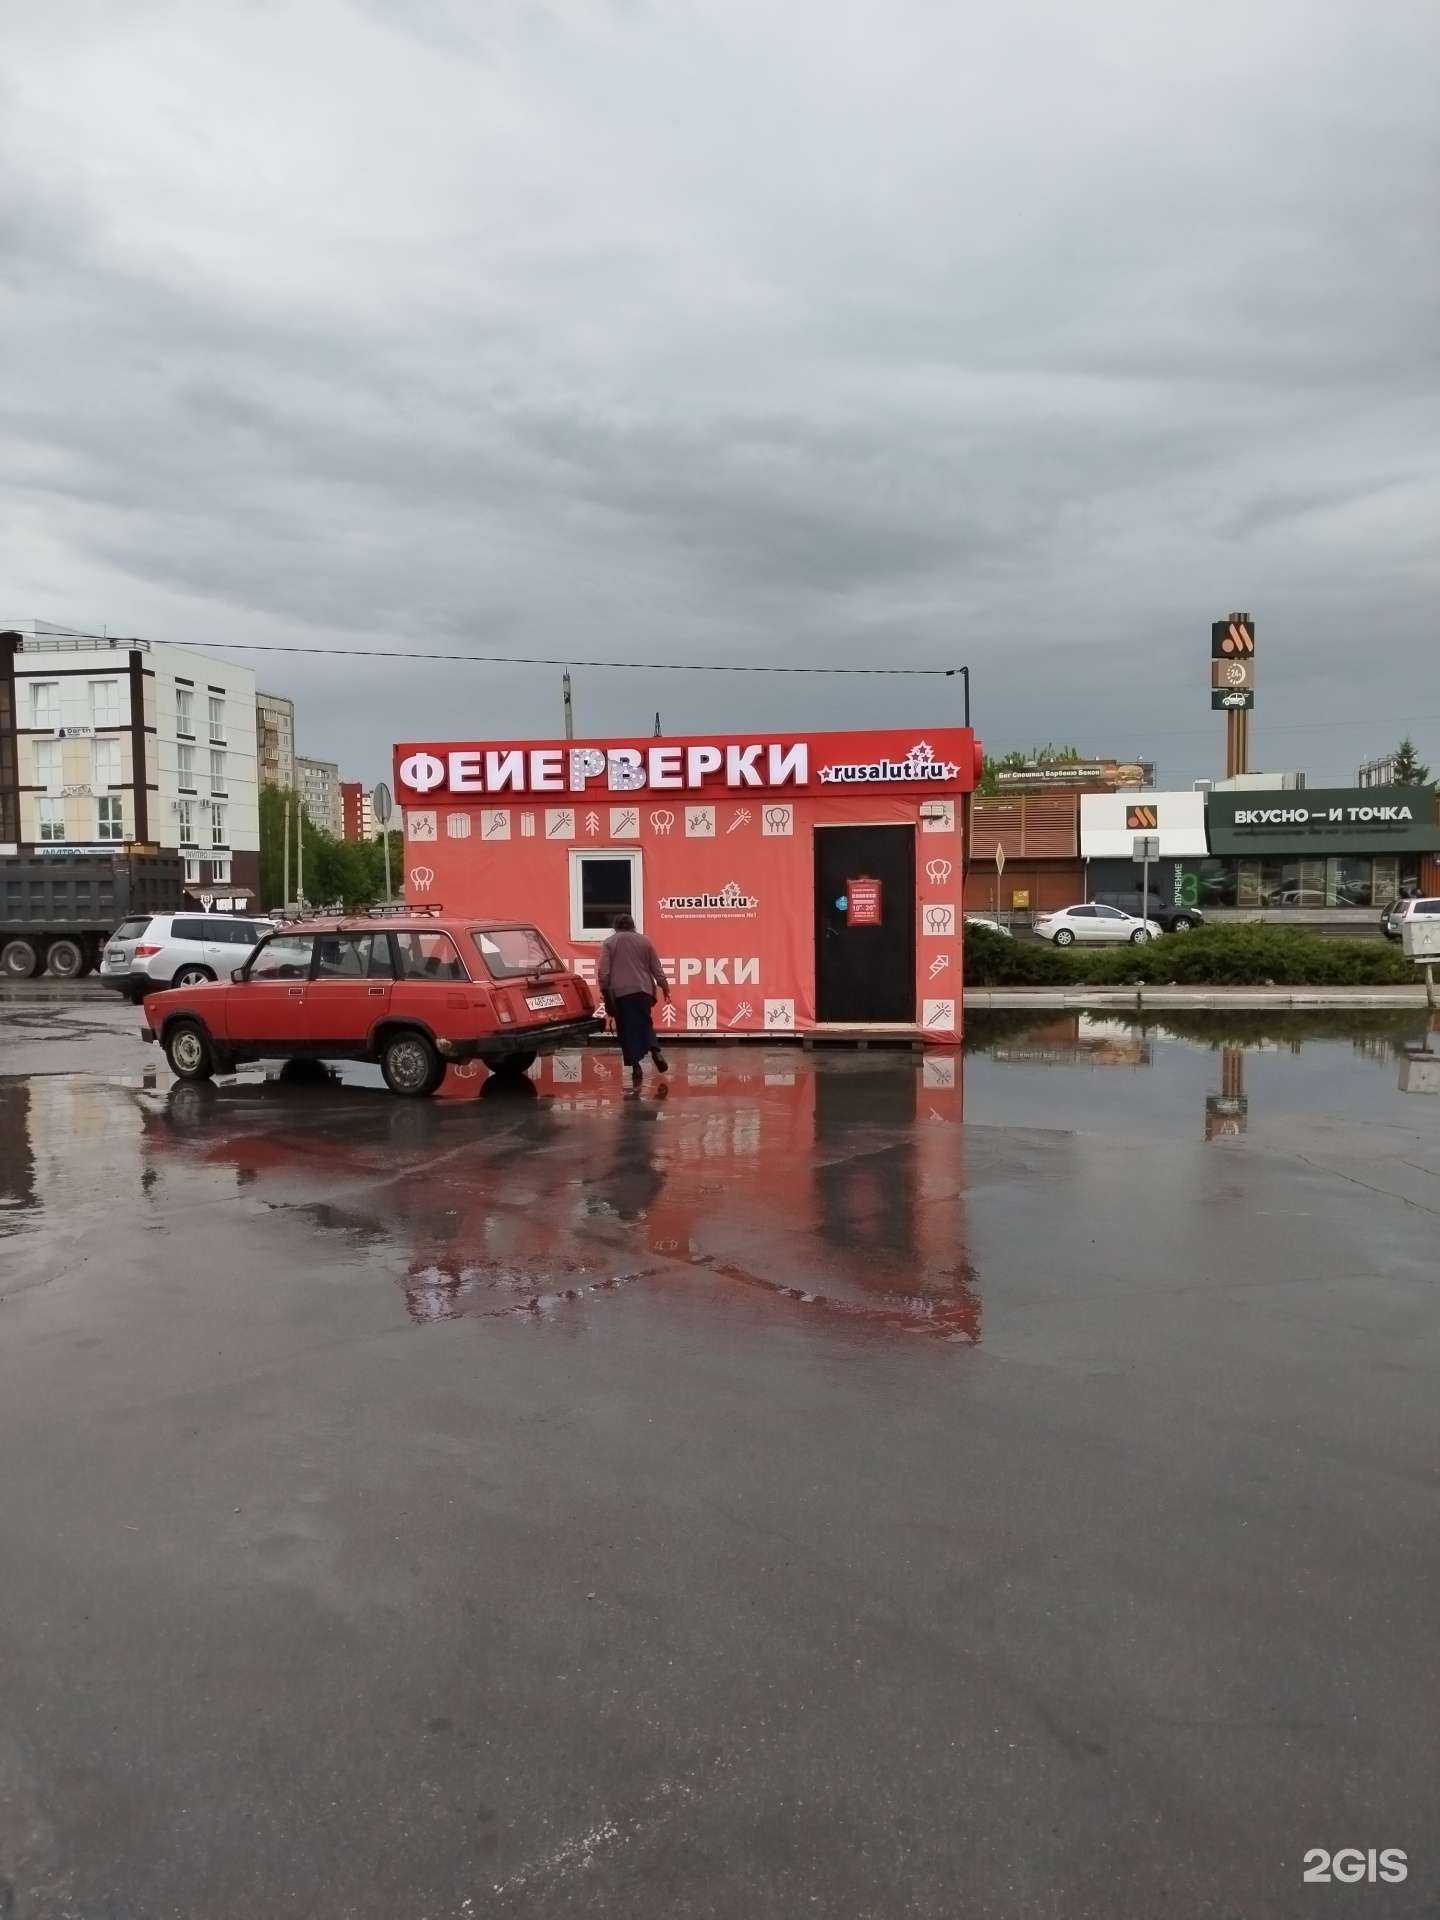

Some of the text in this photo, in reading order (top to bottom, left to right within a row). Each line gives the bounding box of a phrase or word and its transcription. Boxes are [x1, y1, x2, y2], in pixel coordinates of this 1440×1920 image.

[399, 743, 808, 792] ФЕЙЕРВЕРКИ
[834, 761, 943, 779] rusalut.ru
[1234, 809, 1309, 824] ВКУСНО
[1328, 808, 1343, 821] И
[1347, 806, 1412, 821] ТОЧКА
[669, 894, 747, 907] rusalut.ru
